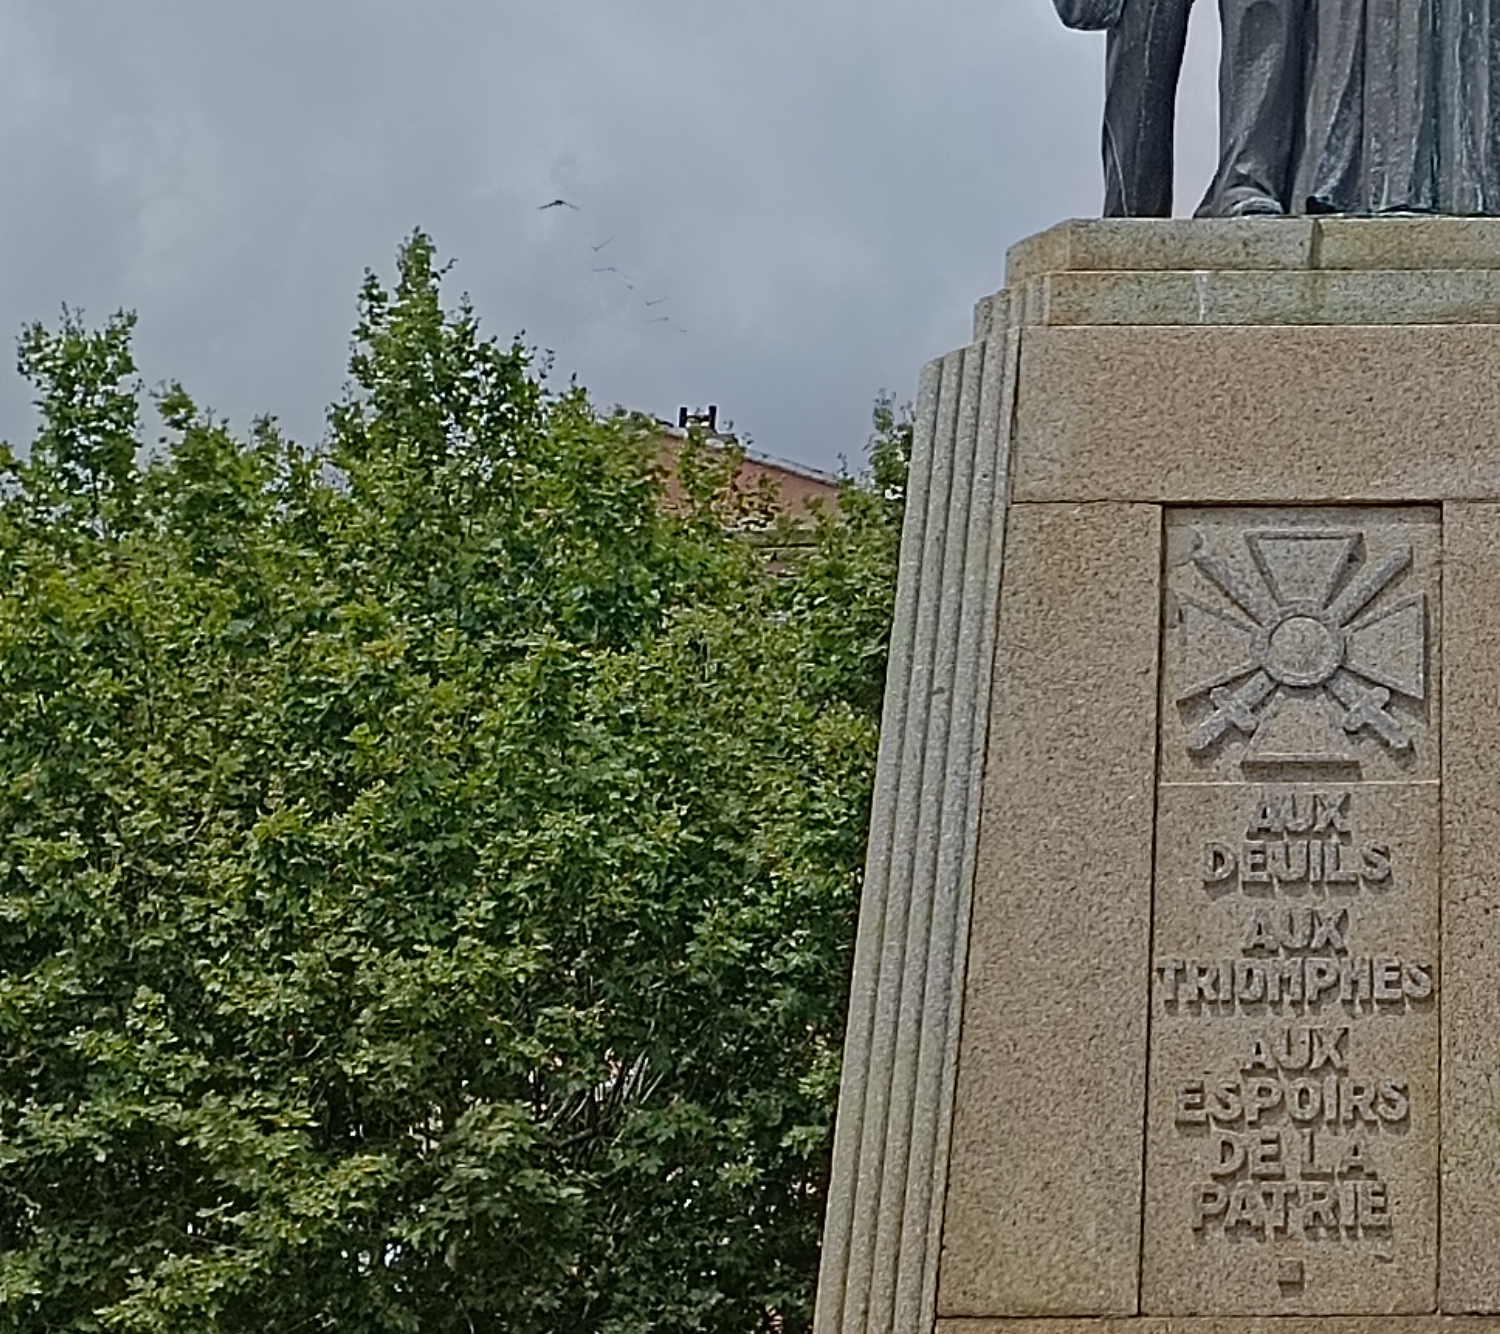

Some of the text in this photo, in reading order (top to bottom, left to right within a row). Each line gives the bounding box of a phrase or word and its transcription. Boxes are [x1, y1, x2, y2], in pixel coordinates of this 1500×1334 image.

[1247, 792, 1351, 838] AUX
[1202, 841, 1392, 889] DEUILS
[1242, 908, 1348, 956] AUX
[1158, 957, 1434, 1011] TRIOMPHES
[1242, 1027, 1348, 1075] AUX
[1175, 1077, 1410, 1130] ESPOIRS
[1211, 1130, 1378, 1180] DE LA
[1193, 1181, 1392, 1237] PATRIE
